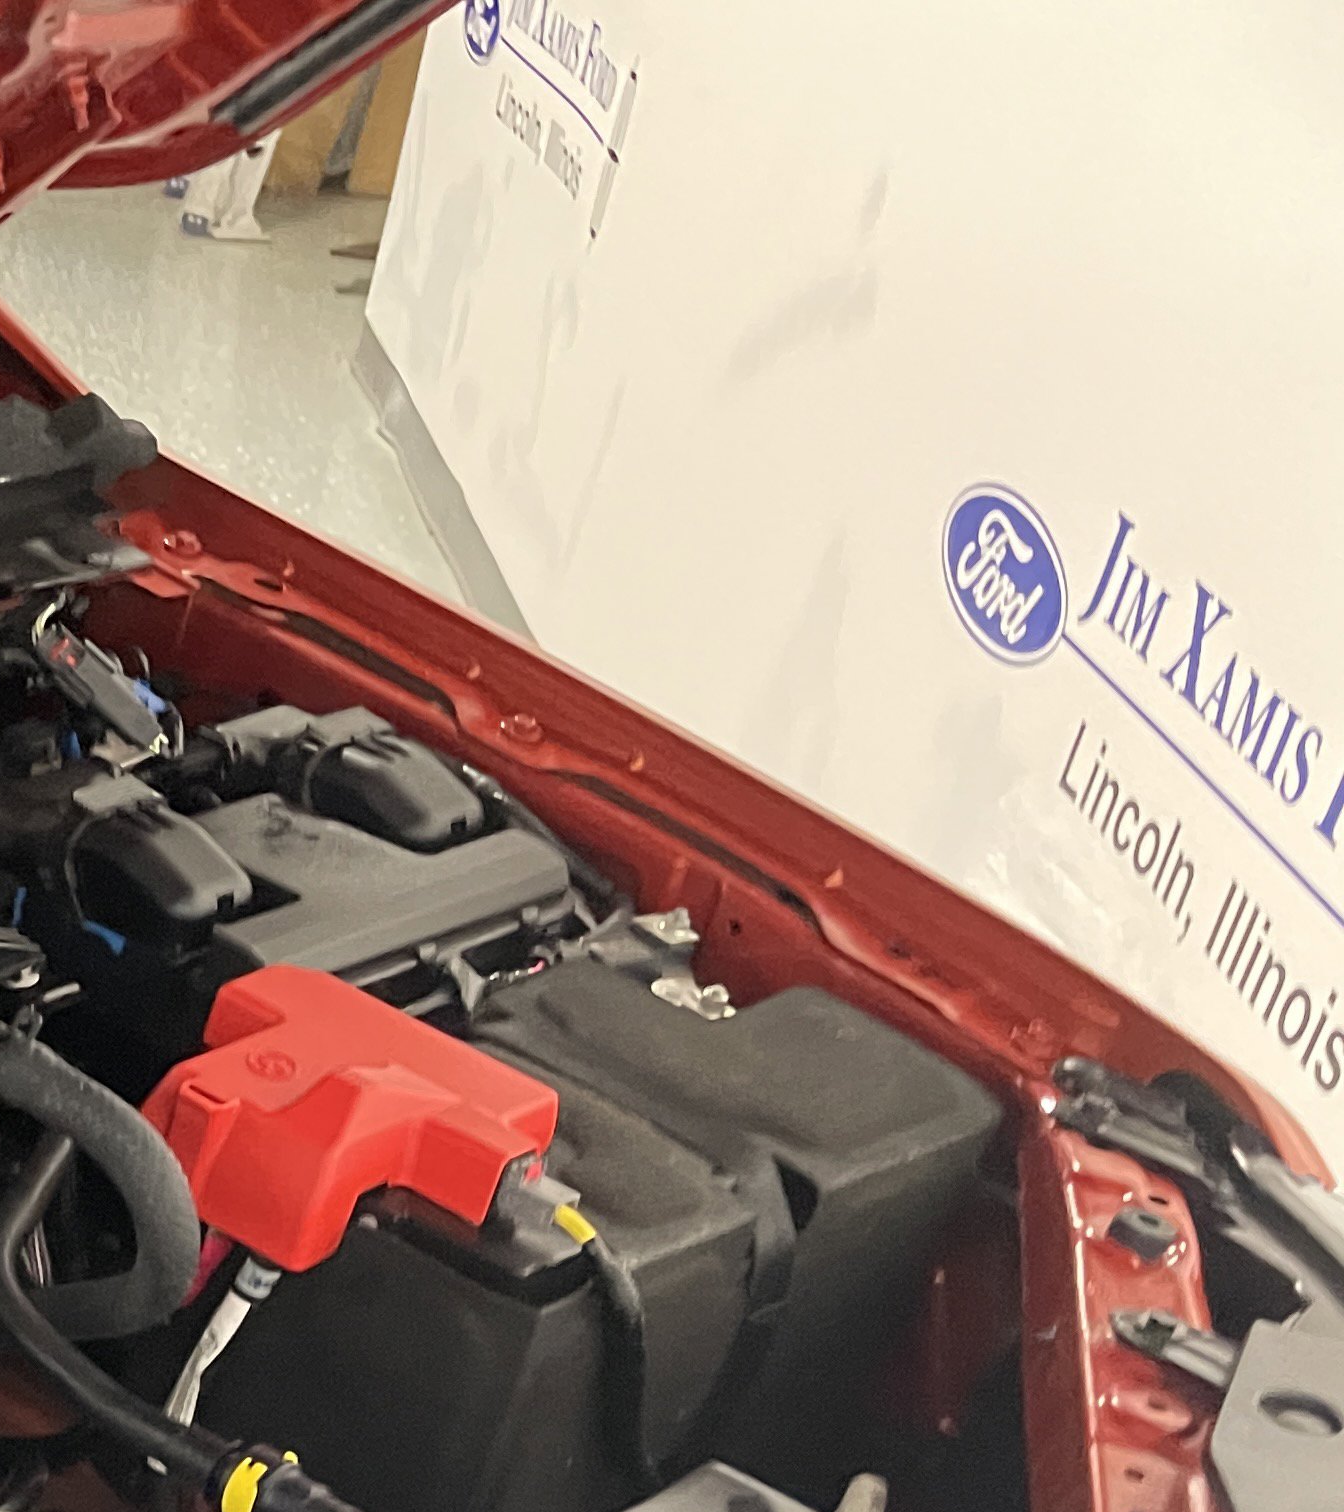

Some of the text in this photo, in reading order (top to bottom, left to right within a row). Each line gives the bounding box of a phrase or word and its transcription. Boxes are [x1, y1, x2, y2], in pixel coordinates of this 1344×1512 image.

[956, 508, 1044, 645] Ford
[1078, 510, 1324, 807] JIM XAMIS
[1058, 719, 1344, 1093] Lincoln, Illinois
